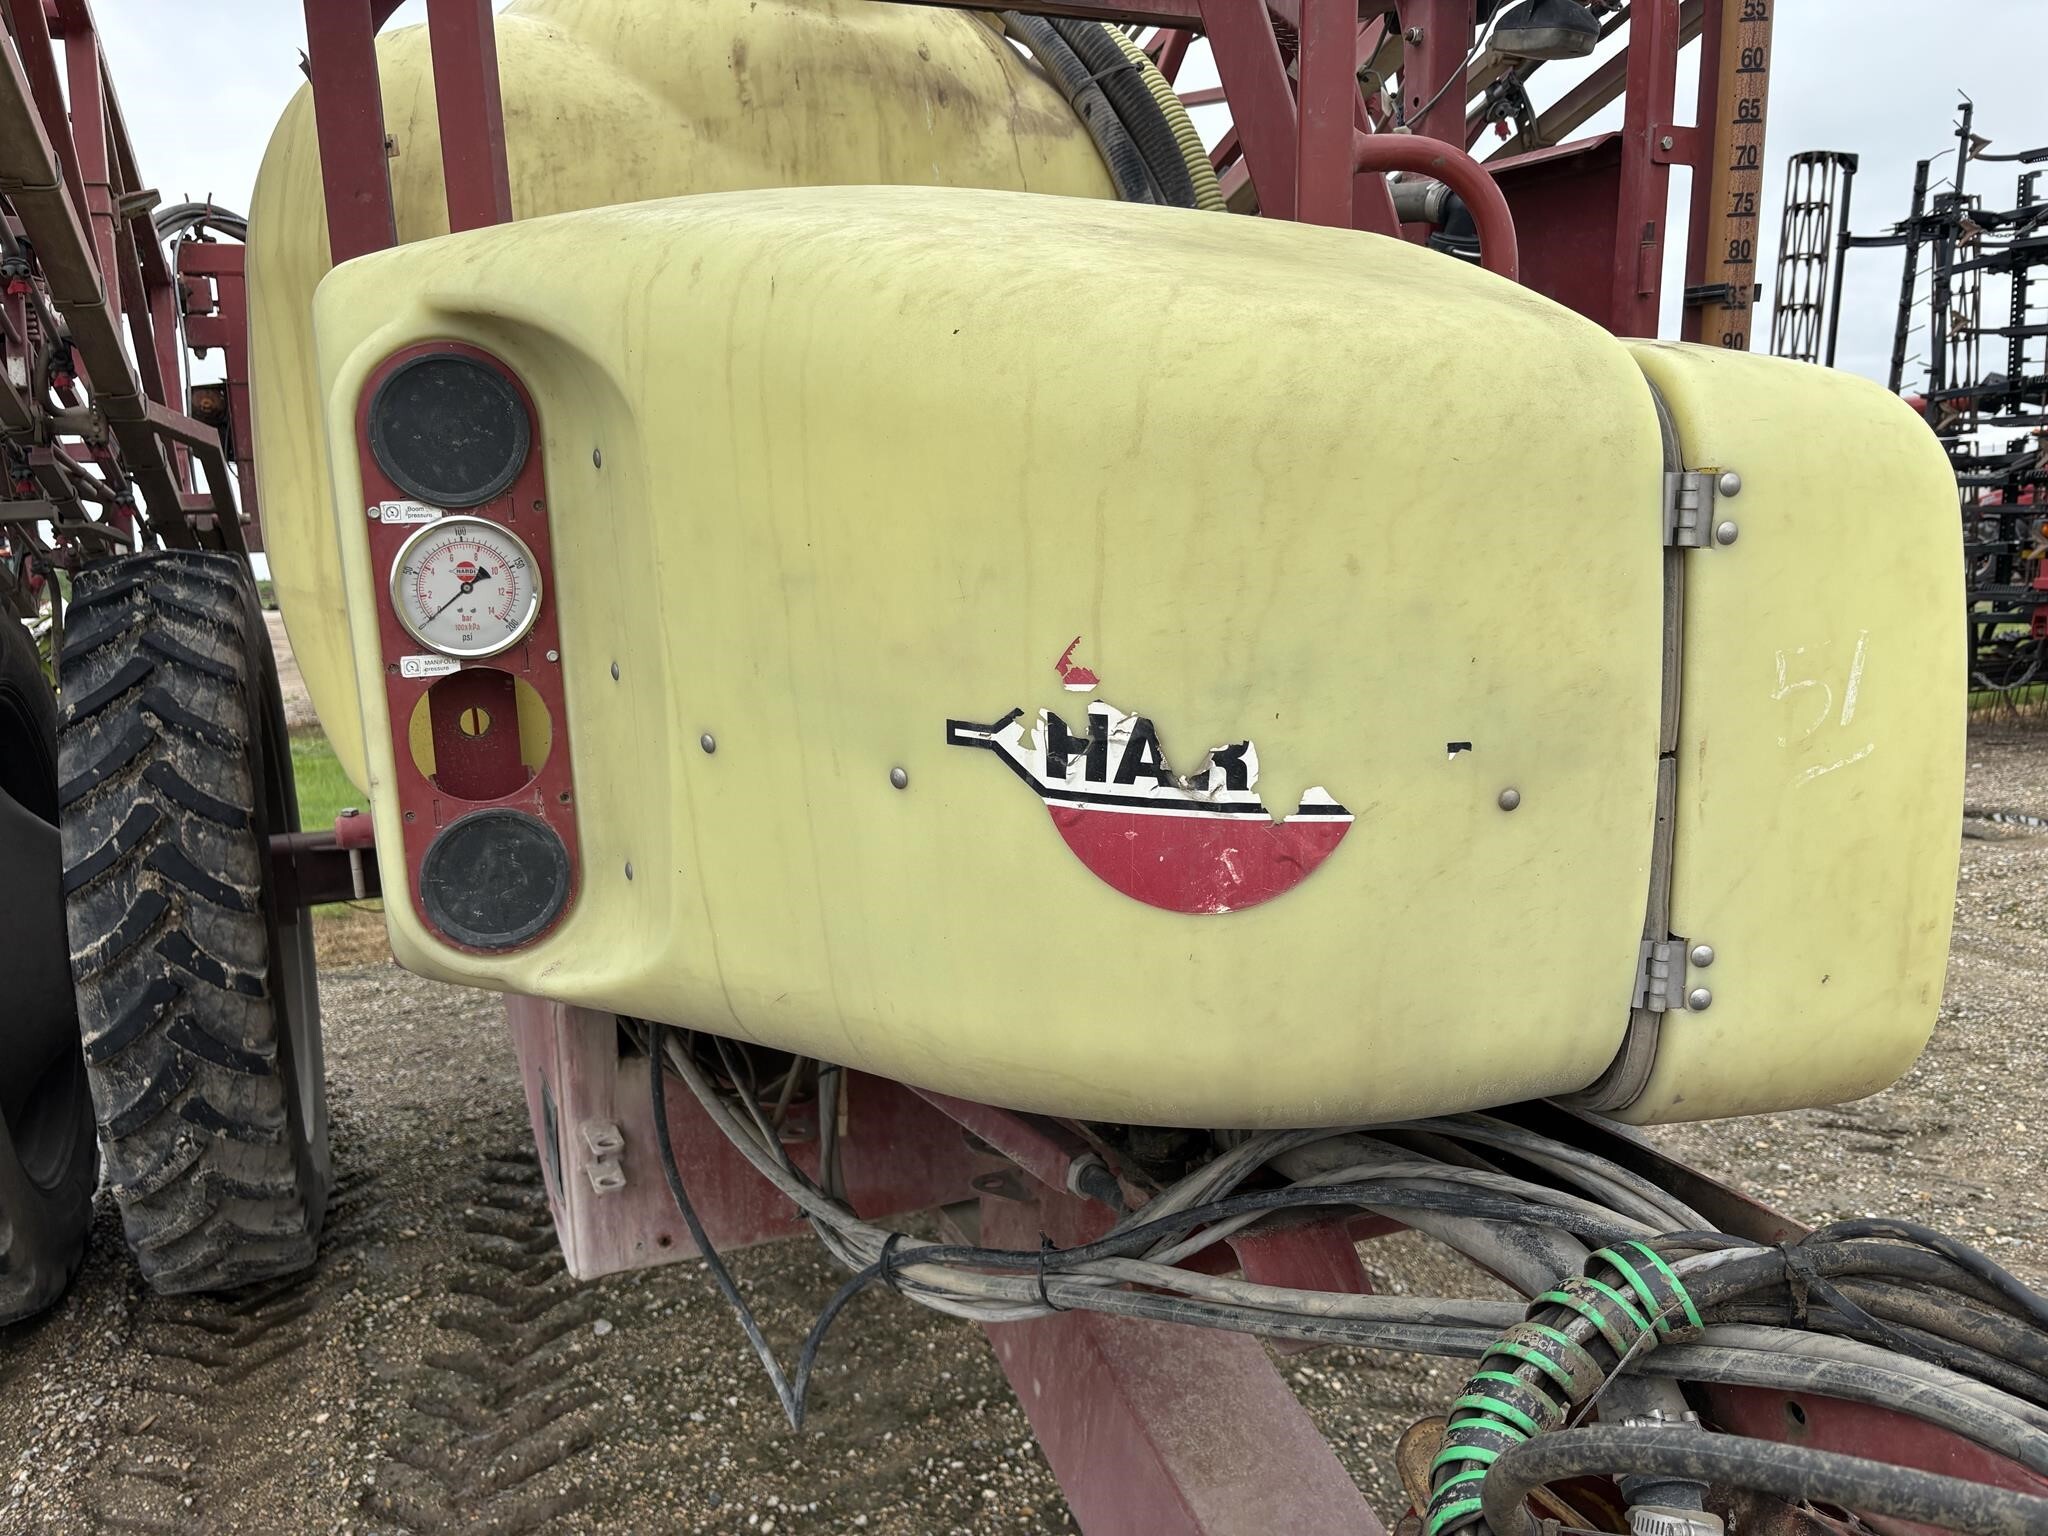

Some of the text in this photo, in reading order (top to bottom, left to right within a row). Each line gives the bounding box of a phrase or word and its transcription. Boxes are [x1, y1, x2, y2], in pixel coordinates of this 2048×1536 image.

[1744, 0, 1766, 17] 55
[1741, 47, 1763, 68] 60
[1738, 98, 1760, 119] 65
[1736, 145, 1757, 166] 70
[1733, 192, 1754, 212] 75
[1728, 239, 1751, 259] 80
[1722, 333, 1744, 350] 90
[454, 527, 467, 536] 100
[461, 614, 473, 622] bar
[462, 632, 473, 642] psi
